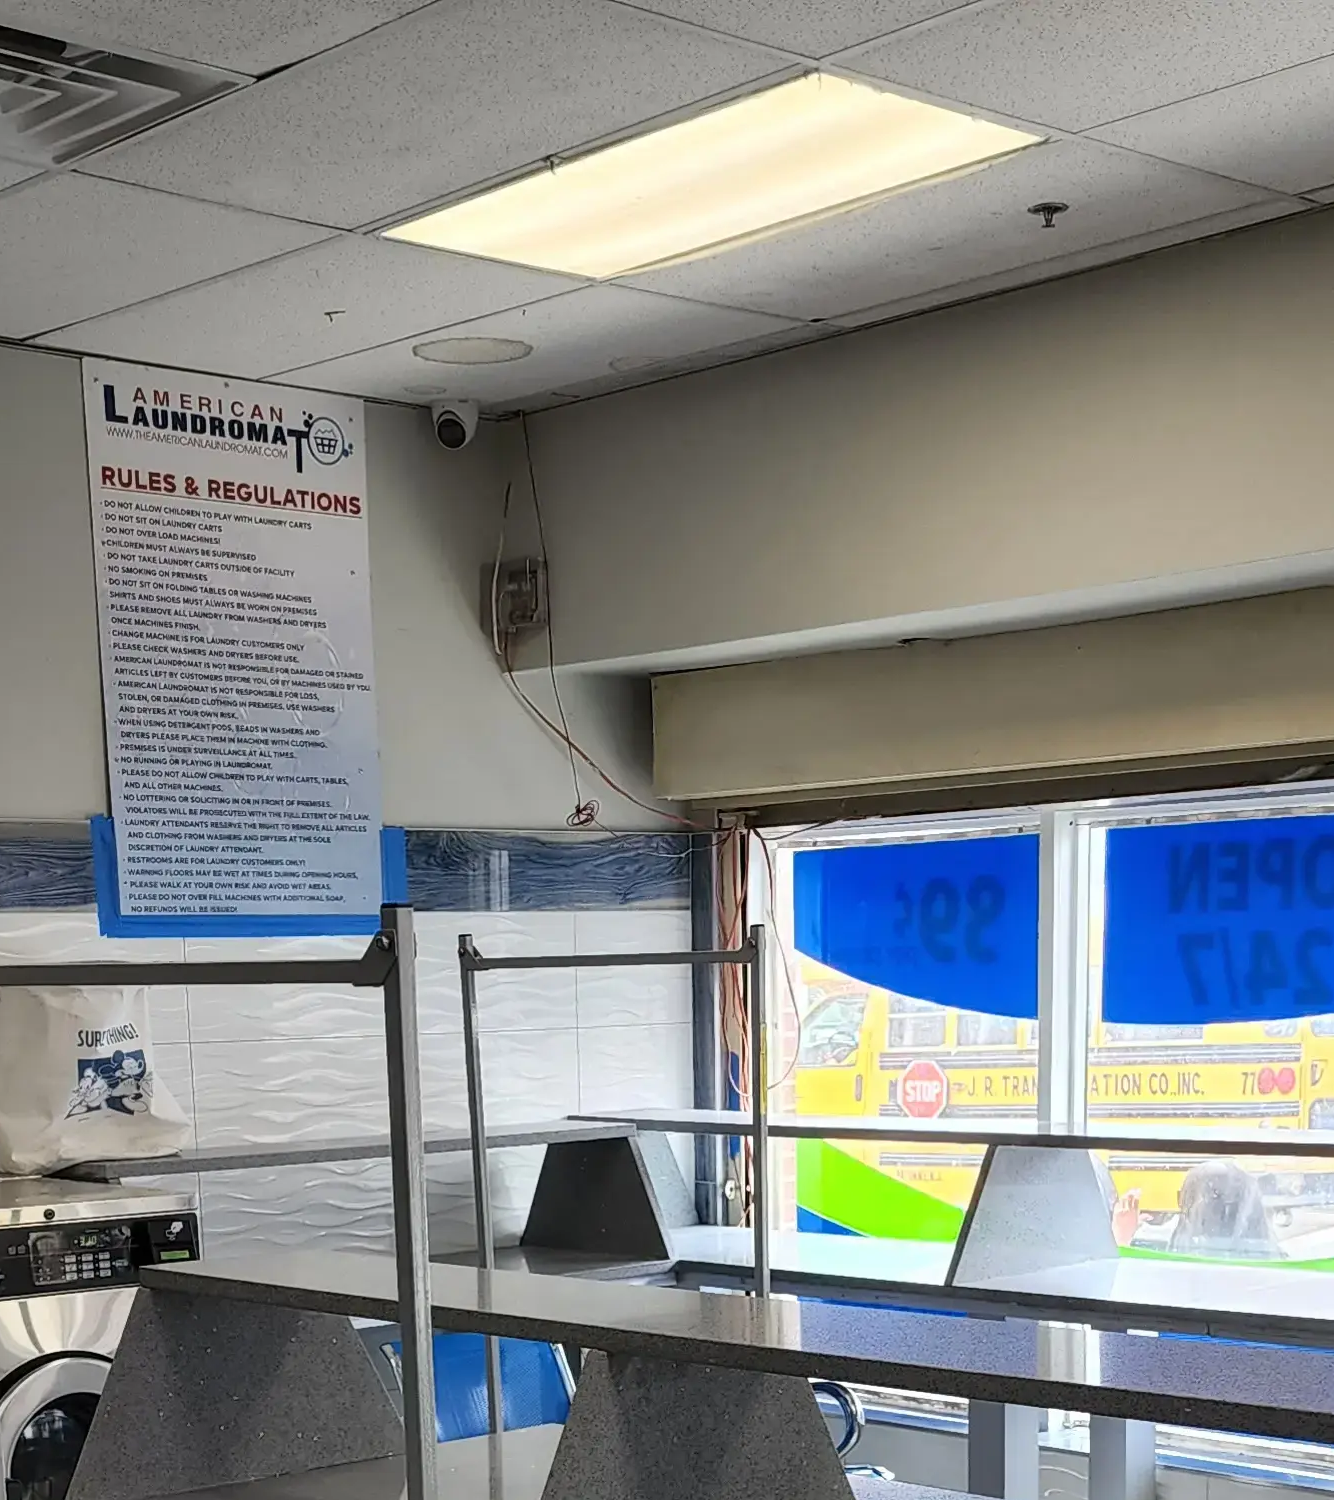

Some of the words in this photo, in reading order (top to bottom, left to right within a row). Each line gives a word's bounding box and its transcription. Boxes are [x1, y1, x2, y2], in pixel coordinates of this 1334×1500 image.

[131, 386, 283, 423] AMERICAN
[102, 384, 310, 474] LAUNDROMAT
[105, 425, 287, 460] WWW.THEAMERICANLAUNDROMAT.COM
[101, 465, 176, 493] RULES
[183, 475, 199, 496] &
[207, 478, 360, 515] REGULATIONS
[116, 501, 132, 510] NOT
[134, 503, 162, 513] ALLOW
[163, 506, 200, 517] CHILDREN
[213, 511, 231, 521] PLAY
[233, 514, 252, 523] WITH
[253, 516, 286, 527] LAUNDRY
[288, 520, 311, 530] CARTS
[117, 514, 133, 523] NOT
[135, 516, 146, 524] SIT
[161, 518, 196, 530] LAUNDRY
[197, 522, 222, 532] CARTS
[118, 527, 134, 536] NOT
[136, 528, 157, 538] OVER
[157, 531, 178, 540] LOAD
[105, 538, 144, 550] CHILDREN
[145, 542, 166, 552] MUST
[168, 545, 199, 555] ALWAYS
[120, 553, 135, 562] NOT
[138, 554, 157, 564] TAKE
[158, 556, 193, 567] LAUNDRY
[194, 560, 219, 570] CARTS
[263, 567, 294, 577] FACILITY
[120, 565, 156, 576] SMOKING
[121, 578, 137, 587] NOT
[138, 580, 150, 589] SIT
[165, 582, 197, 593] FOLDING
[199, 586, 226, 596] TABLES
[137, 593, 154, 602] AND
[155, 594, 181, 604] SHOES
[182, 597, 202, 606] MUST
[204, 599, 234, 609] ALWAYS
[247, 602, 269, 612] WORN
[109, 603, 139, 613] PLEASE
[140, 605, 171, 616] REMOVE
[173, 608, 186, 617] ALL
[188, 610, 222, 620] LAUNDRY
[224, 613, 245, 622] FROM
[282, 618, 298, 626] AND
[110, 616, 132, 625] ONCE
[111, 629, 144, 639] CHANGE
[145, 631, 179, 642] MACHINE
[189, 635, 204, 643] FOR
[205, 636, 239, 646] LAUNDRY
[285, 643, 304, 651] ONLY
[112, 641, 141, 651] PLEASE
[142, 644, 168, 653] CHECK
[208, 649, 224, 657] AND
[118, 705, 135, 713] AND
[178, 708, 198, 717] YOUR
[199, 710, 218, 718] OWN
[133, 756, 167, 765] RUNNING
[180, 758, 212, 767] PLAYING
[141, 781, 155, 789] ALL
[157, 782, 182, 790] OTHER
[127, 843, 172, 851] DISCRETION
[126, 855, 172, 863] RESTROOMS
[174, 856, 189, 864] ARE
[205, 857, 239, 865] LAUNDRY
[904, 1079, 941, 1103] STOP
